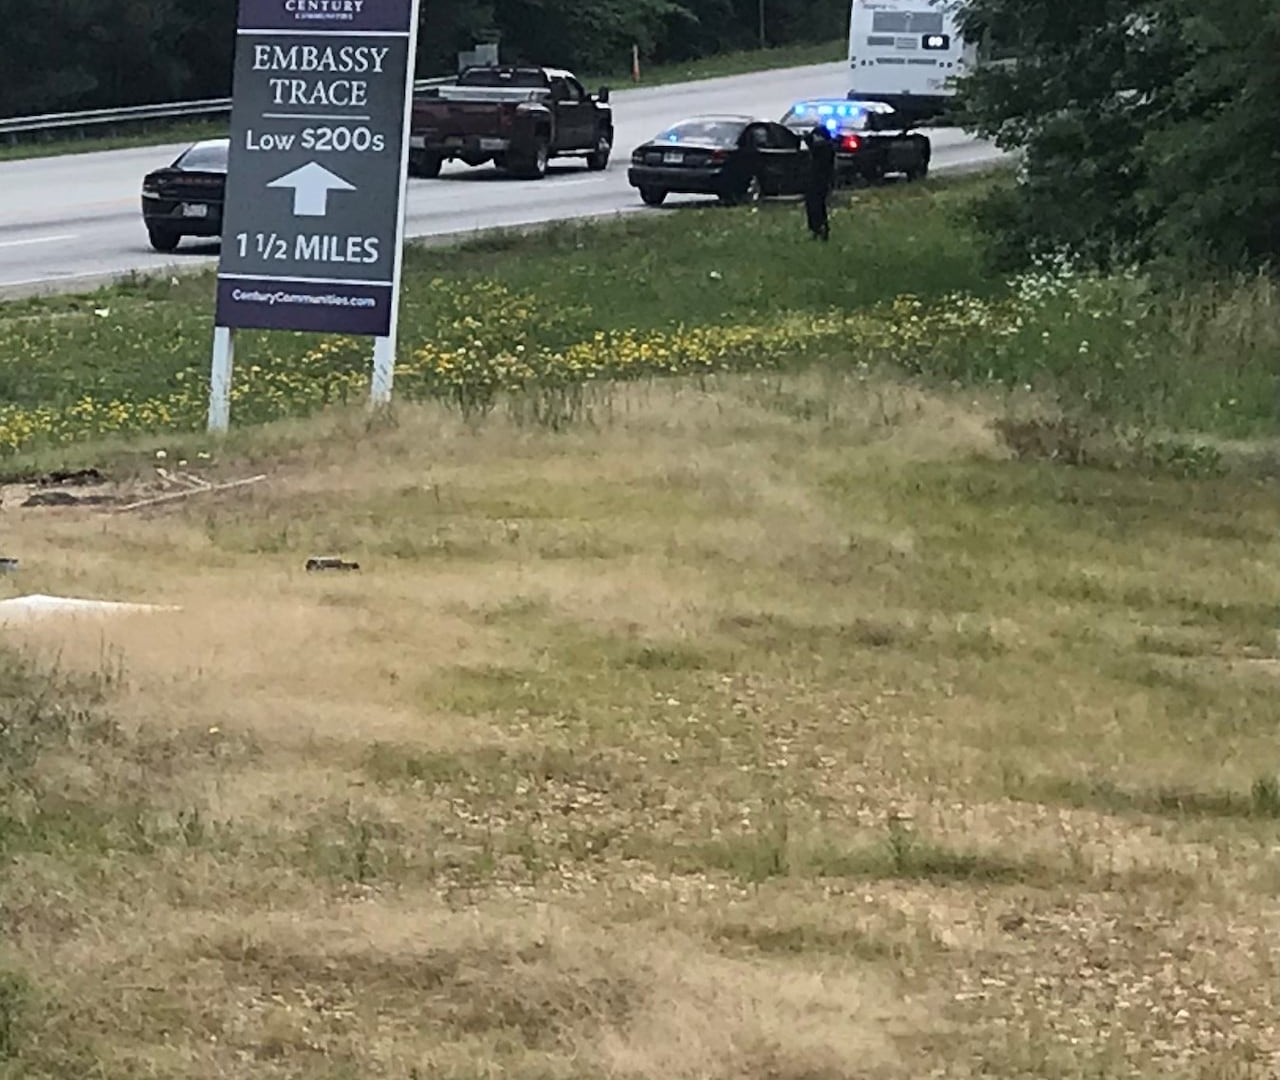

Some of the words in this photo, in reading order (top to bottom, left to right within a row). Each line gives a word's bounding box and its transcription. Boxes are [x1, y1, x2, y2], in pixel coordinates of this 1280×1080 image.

[285, 0, 364, 12] CENTURY
[252, 45, 389, 72] EMBASSY
[269, 79, 368, 106] TRACE
[246, 129, 296, 151] Low
[301, 126, 385, 152] $200s
[236, 232, 248, 257] 1
[294, 234, 380, 263] MILES
[232, 288, 376, 307] CenturyCommunities.com
